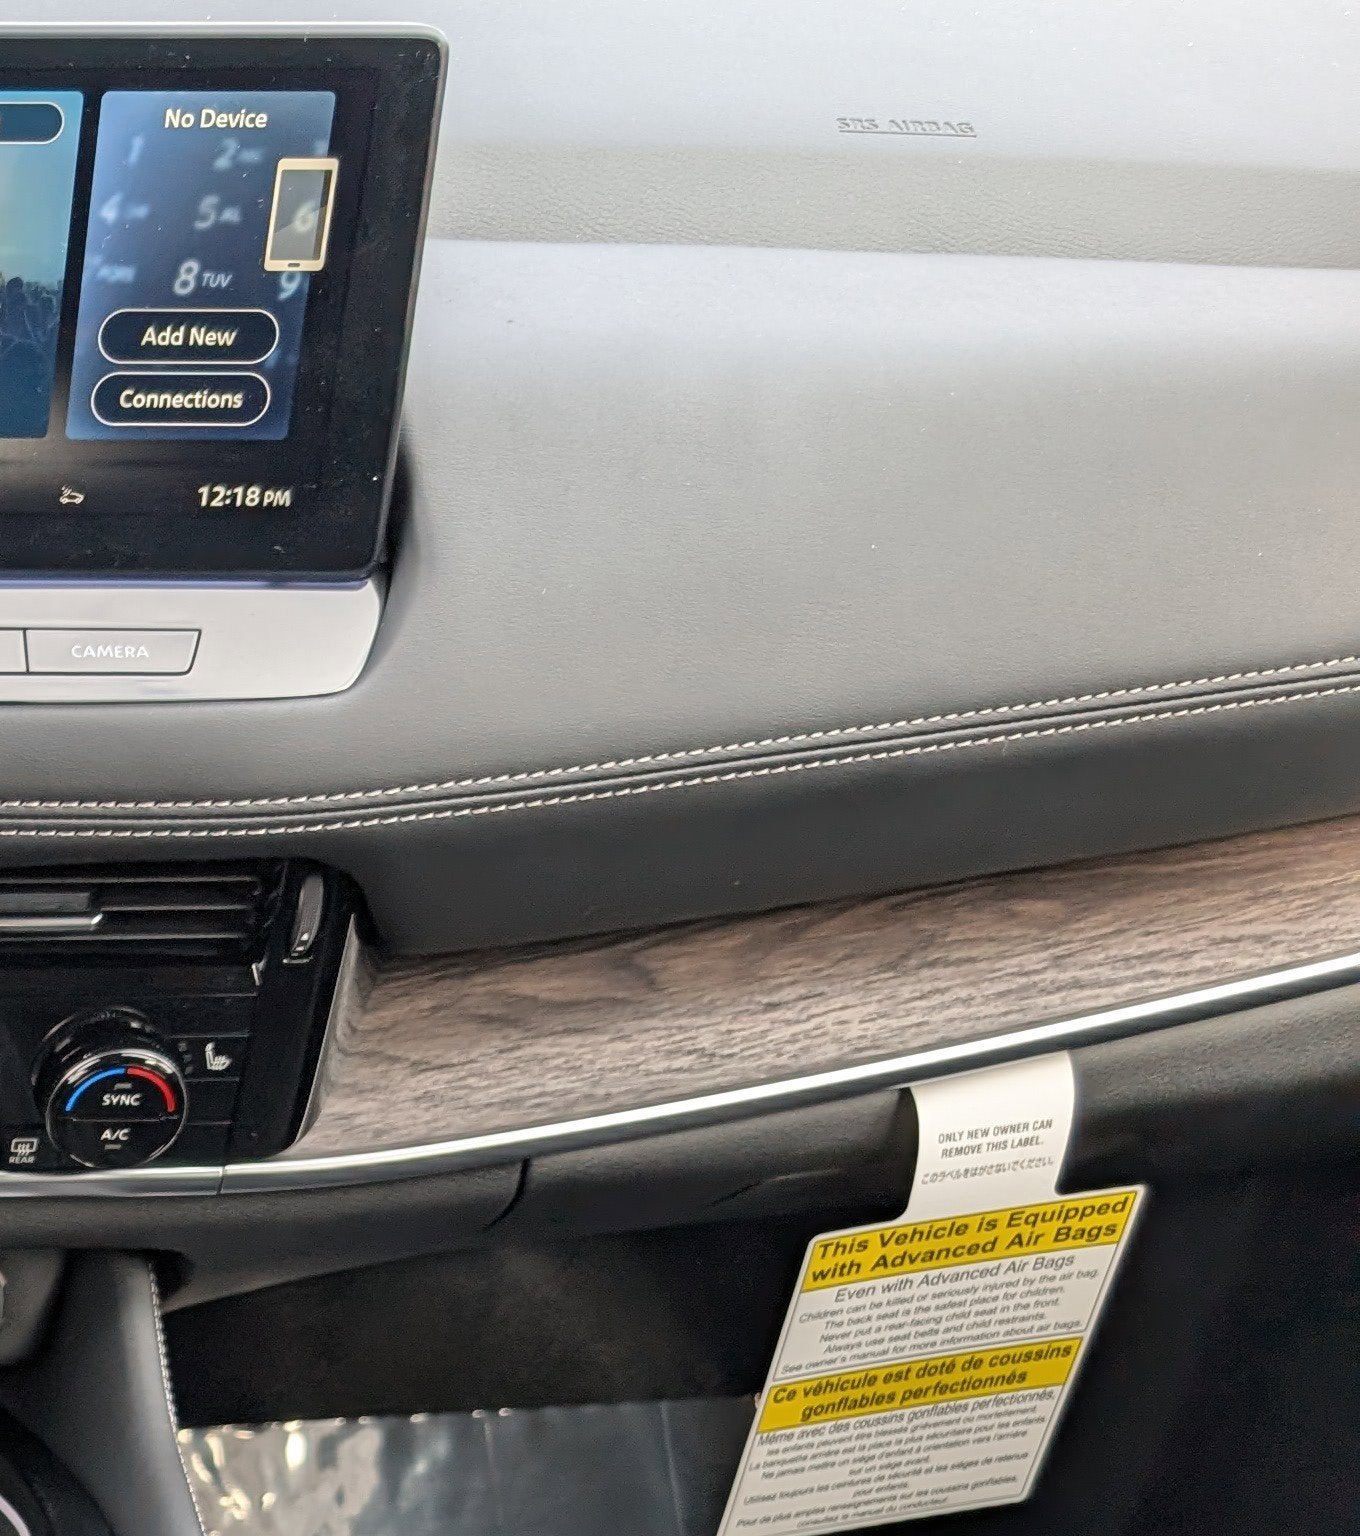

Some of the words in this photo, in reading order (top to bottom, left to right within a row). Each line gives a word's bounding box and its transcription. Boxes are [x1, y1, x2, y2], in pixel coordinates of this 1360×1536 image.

[164, 108, 195, 129] No
[200, 107, 268, 130] Device
[141, 325, 185, 347] Add
[189, 325, 238, 347] New
[118, 388, 244, 411] Connections
[197, 484, 260, 508] 12:18
[262, 489, 292, 508] PM
[71, 644, 149, 659] CAMERA
[101, 1093, 141, 1107] SYNC
[100, 1127, 130, 1143] A/C
[938, 1131, 964, 1144] ONLY
[967, 1128, 991, 1140] NEW
[992, 1122, 1030, 1137] OWNER
[1032, 1119, 1053, 1132] CAN
[8, 1154, 36, 1164] REAR
[941, 1143, 982, 1159] REMOVE
[986, 1140, 1008, 1153] THIS
[1010, 1135, 1044, 1149] LABEL.
[819, 1238, 870, 1260] This
[879, 1221, 970, 1248] Vehicle
[975, 1216, 999, 1233] is
[1006, 1197, 1129, 1228] Equipped
[811, 1259, 862, 1282] with
[870, 1236, 999, 1272] Advanced
[1004, 1230, 1045, 1250] Air
[1052, 1223, 1118, 1243] Bags
[834, 1284, 876, 1303] Even
[880, 1277, 914, 1294] with
[916, 1262, 1002, 1289] Advanced
[1002, 1259, 1029, 1275] Air
[1031, 1254, 1075, 1271] Bags
[772, 1387, 798, 1404] Ce
[802, 1373, 878, 1399] véhicule
[882, 1367, 912, 1385] est
[914, 1357, 957, 1379] doté
[960, 1355, 984, 1372] de
[989, 1344, 1073, 1369] coussins
[801, 1390, 896, 1422] gonflables
[899, 1370, 1028, 1405] perfectionnés
